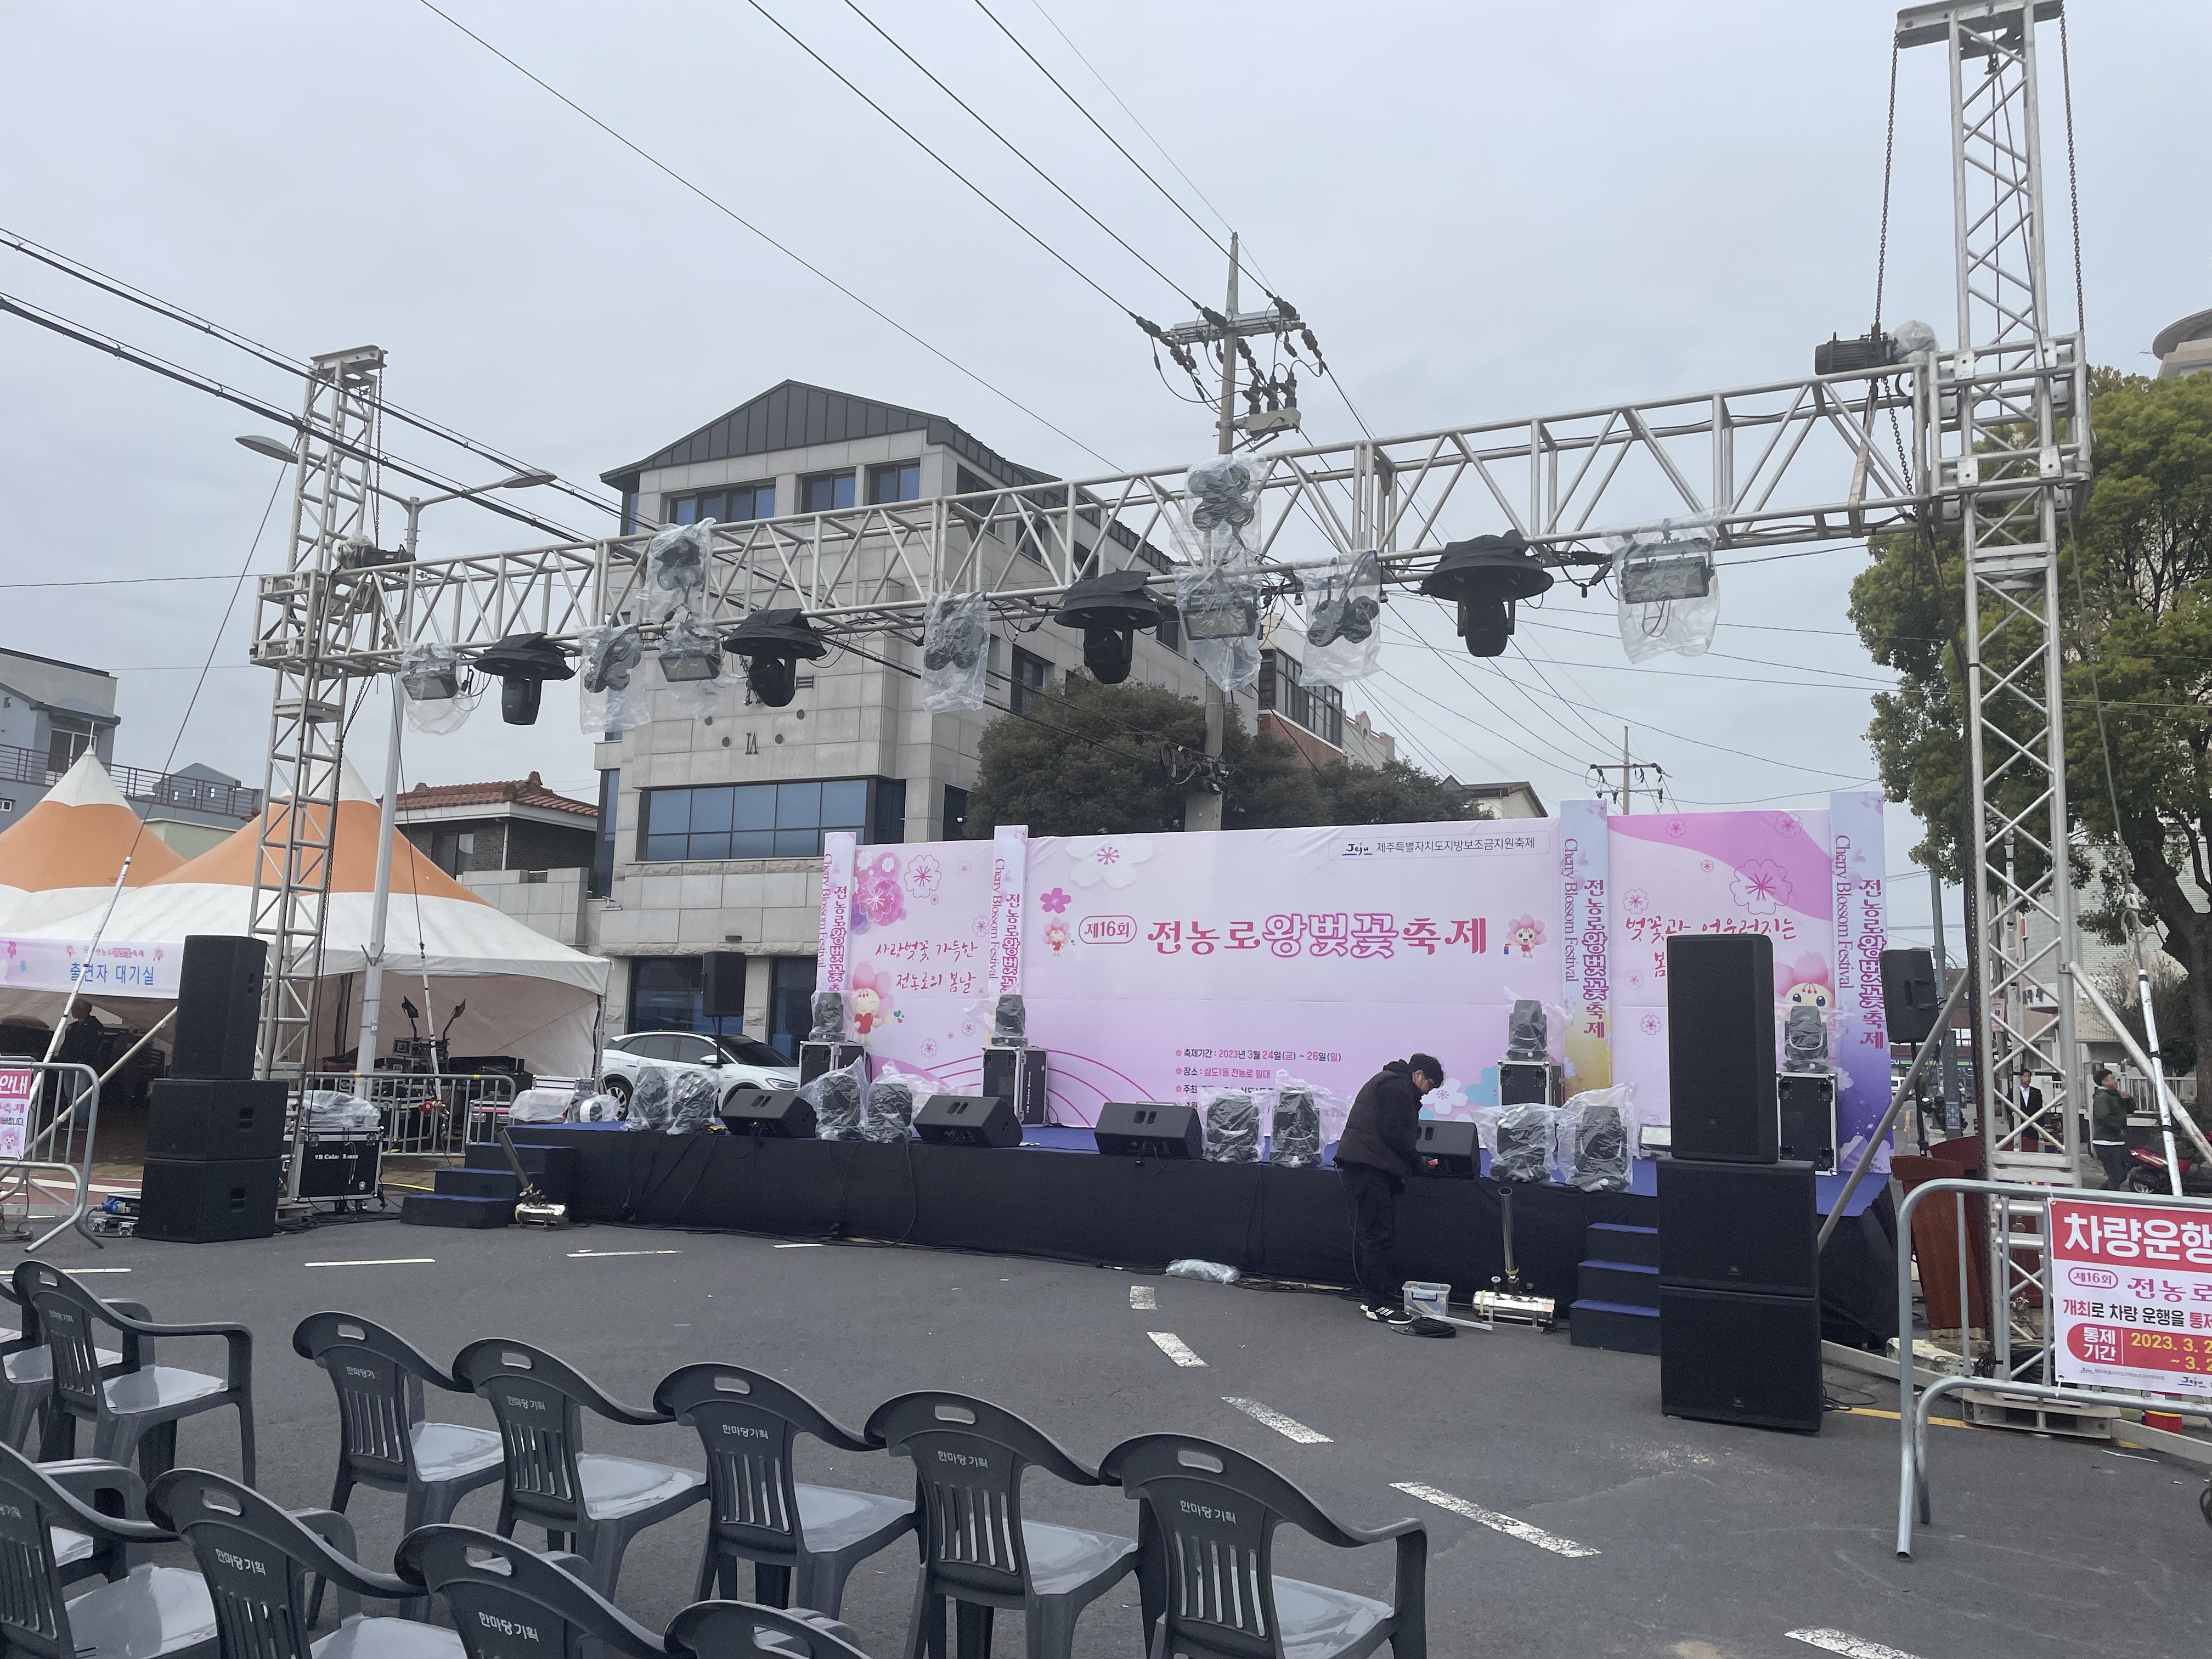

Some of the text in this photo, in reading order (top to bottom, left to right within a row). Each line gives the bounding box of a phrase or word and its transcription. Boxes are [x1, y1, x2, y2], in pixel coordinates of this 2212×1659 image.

[1346, 837, 1534, 856] Jeju 제주특별자치도지방보조금지원축제
[818, 853, 832, 967] Cherry Blossom Festival
[989, 859, 1005, 979] Cherry Blossom Festival
[1561, 838, 1579, 982] Cherry Blossom Festival
[1833, 835, 1854, 989] Cherry Blossom Festival
[1084, 913, 1486, 959] 제16회 전농로왕벚꽃축제
[1626, 916, 1691, 944] 벚꽃과
[875, 940, 978, 962] 사랑벚꽃 가득한
[1582, 879, 1609, 1038] 전농로왕벚꽃축제
[70, 962, 154, 985] 출연자 대기실
[896, 972, 977, 993] 전농로의 봄날
[1184, 1049, 1212, 1058] 축제기간
[1219, 1050, 1245, 1059] 2023년
[1248, 1050, 1260, 1060] 3월
[1262, 1051, 1296, 1061] 24일(금)
[1307, 1051, 1341, 1062] 26일(일)
[1183, 1067, 1198, 1076] 장소
[1204, 1068, 1229, 1077] 삼도1동
[1231, 1068, 1254, 1078] 전농로
[1256, 1069, 1271, 1079] 일대
[0, 1075, 29, 1094] 안내
[1183, 1085, 1197, 1093] 주최
[2074, 1272, 2112, 1285] 제16회
[2063, 1299, 2104, 1318] 개최로
[2109, 1304, 2137, 1322] 차량
[2142, 1307, 2184, 1327] 운행을
[2084, 1327, 2116, 1345] 통제
[2131, 1332, 2177, 1351] 2023.
[2183, 1338, 2199, 1353] 3.
[2084, 1344, 2117, 1362] 기간
[2185, 1356, 2200, 1370] 3.
[2182, 1376, 2203, 1387] Jeju
